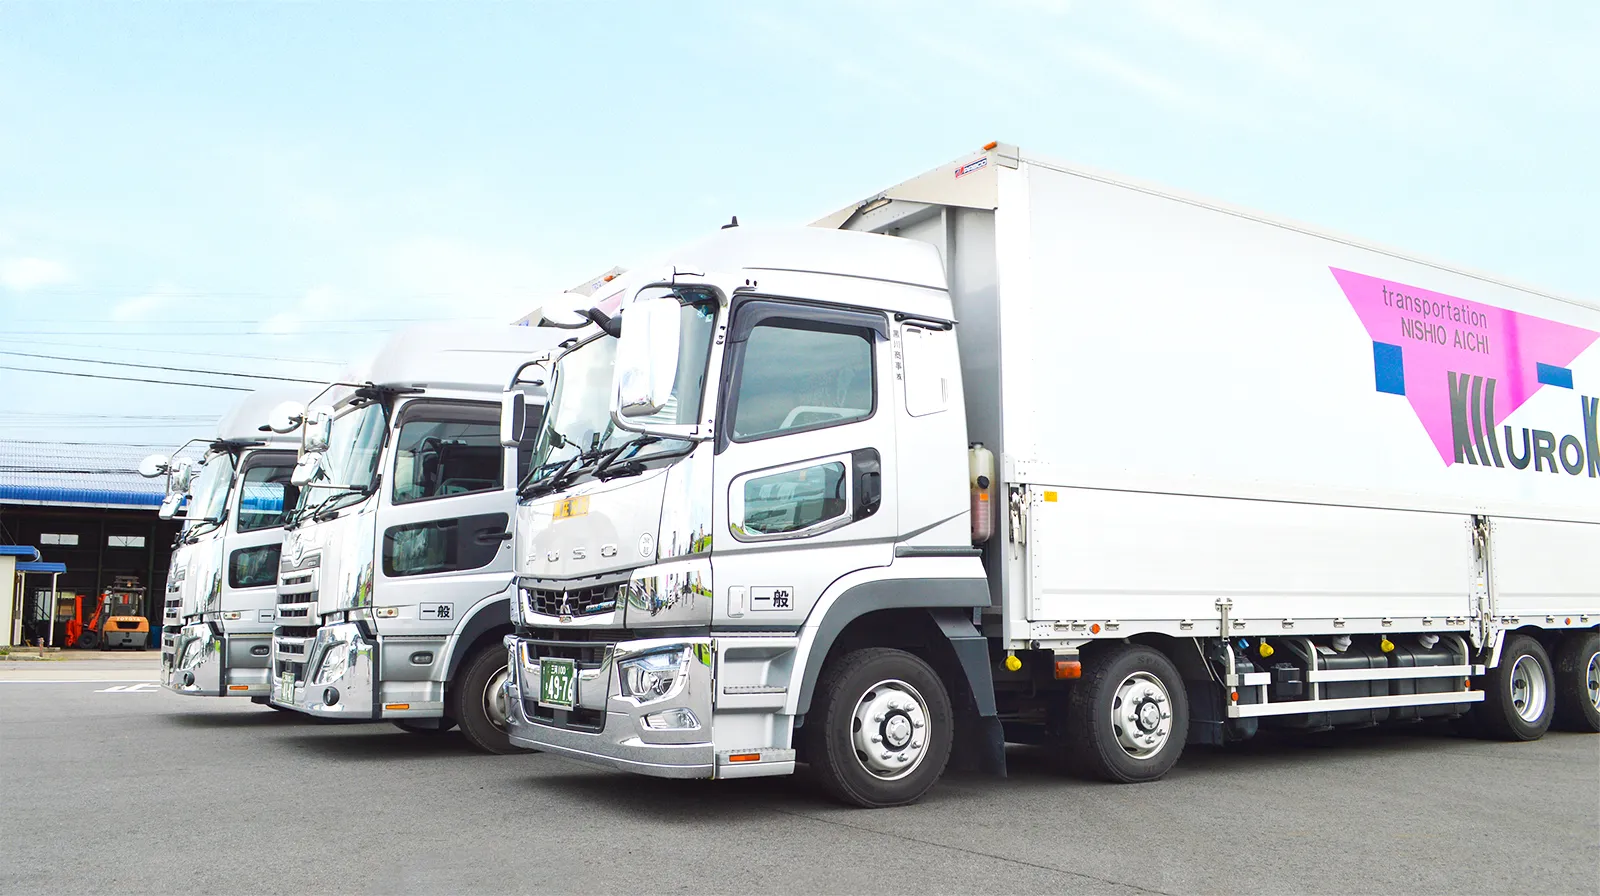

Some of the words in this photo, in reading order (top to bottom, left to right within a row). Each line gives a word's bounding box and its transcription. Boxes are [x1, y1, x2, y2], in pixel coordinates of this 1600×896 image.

[1382, 285, 1488, 329] transportation
[1400, 316, 1447, 346] NISHIO
[1453, 329, 1490, 354] AICHI
[525, 543, 618, 566] FUSO
[422, 604, 451, 618] 一般
[754, 589, 789, 608] 一般
[548, 674, 573, 702] 49-76
